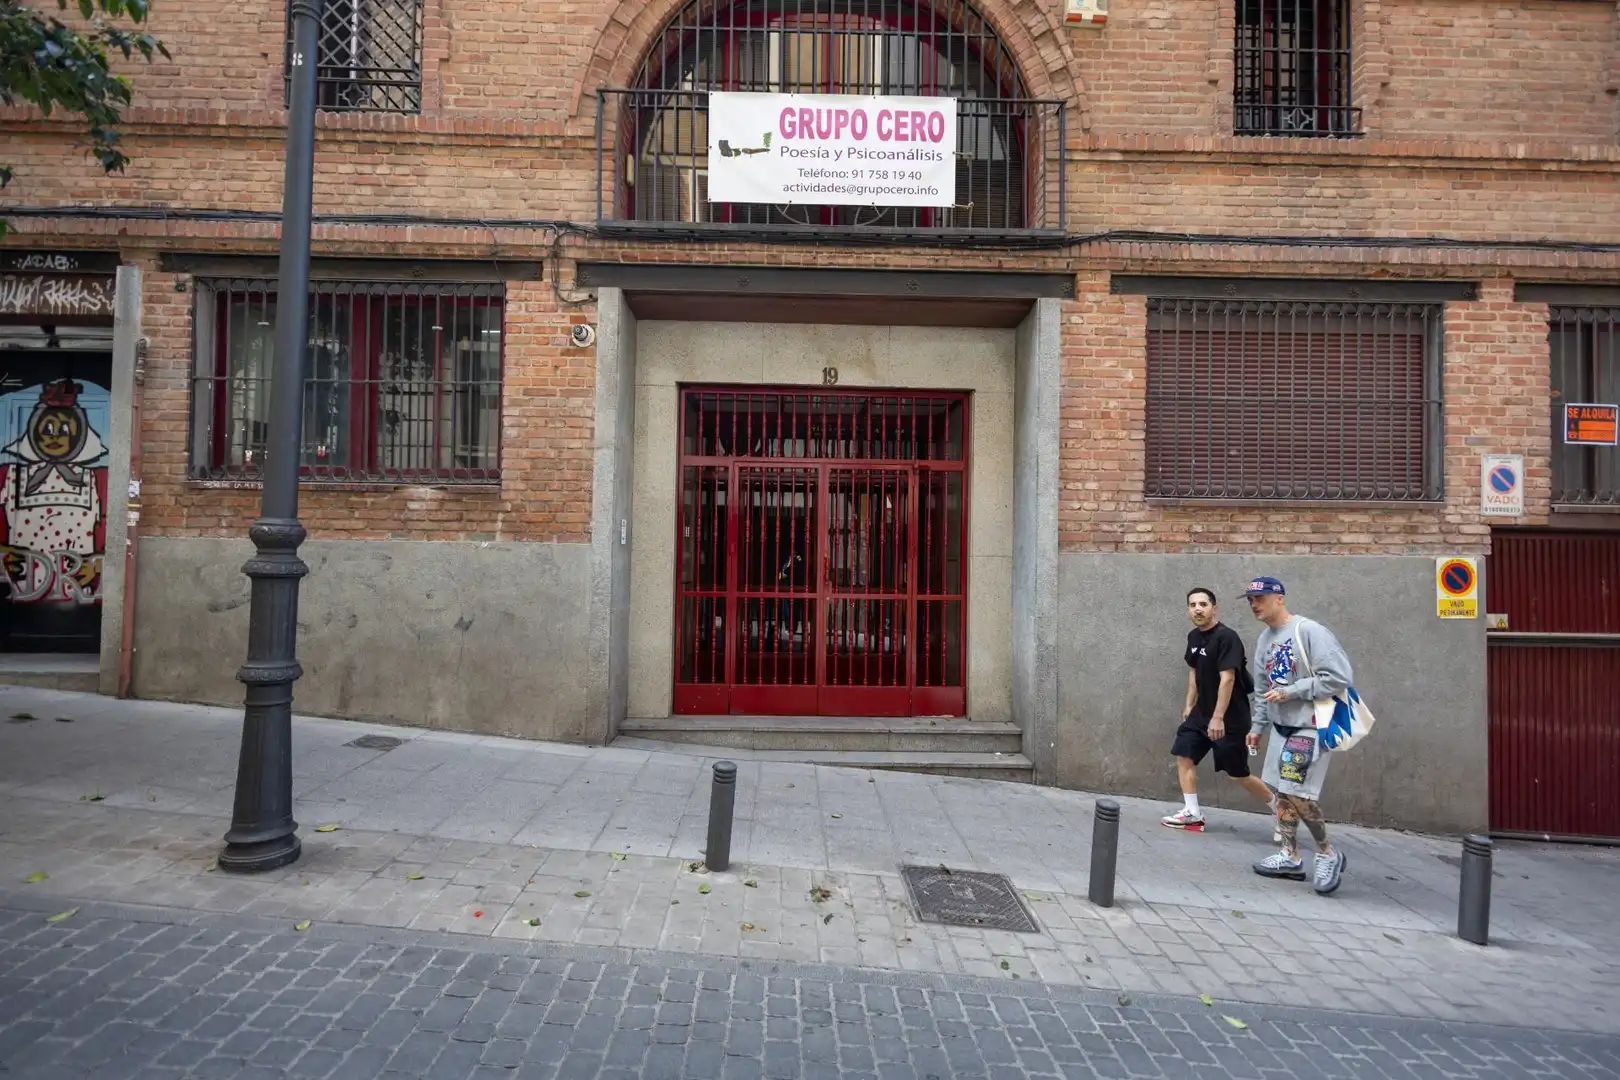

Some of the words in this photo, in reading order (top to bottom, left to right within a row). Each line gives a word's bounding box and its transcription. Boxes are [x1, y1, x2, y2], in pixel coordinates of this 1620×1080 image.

[779, 107, 868, 140] GRUPO
[877, 109, 945, 143] CERO
[780, 145, 830, 158] Poesía
[834, 149, 843, 162] y
[847, 147, 943, 162] Psicoanálisis
[797, 168, 849, 179] Teléfono:
[851, 169, 864, 179] 91
[868, 170, 889, 180] 758
[892, 170, 905, 180] 19
[908, 171, 922, 180] 40
[782, 183, 939, 196] actividades@grupocero.info
[822, 367, 838, 385] 19
[1568, 407, 1578, 418] SE
[1581, 408, 1615, 419] ALQUILA
[1487, 495, 1519, 505] VADO
